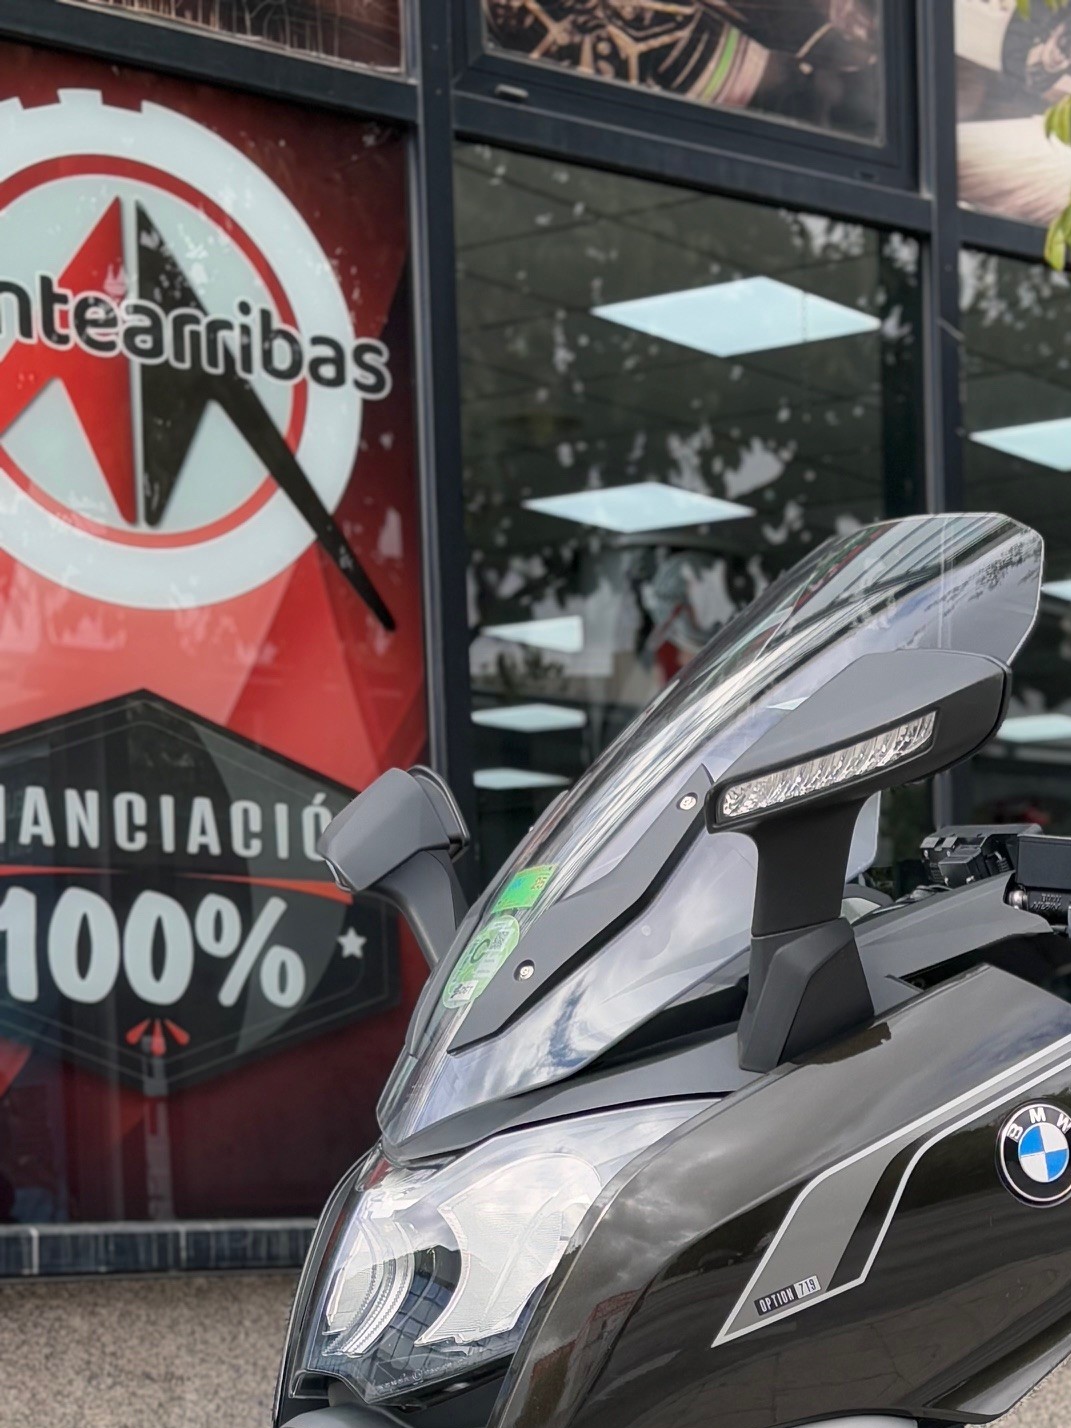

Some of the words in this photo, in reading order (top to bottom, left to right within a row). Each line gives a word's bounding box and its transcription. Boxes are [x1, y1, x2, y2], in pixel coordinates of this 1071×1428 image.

[0, 886, 306, 1008] 100%
[758, 1287, 795, 1313] OPTION
[798, 1278, 817, 1297] 719
